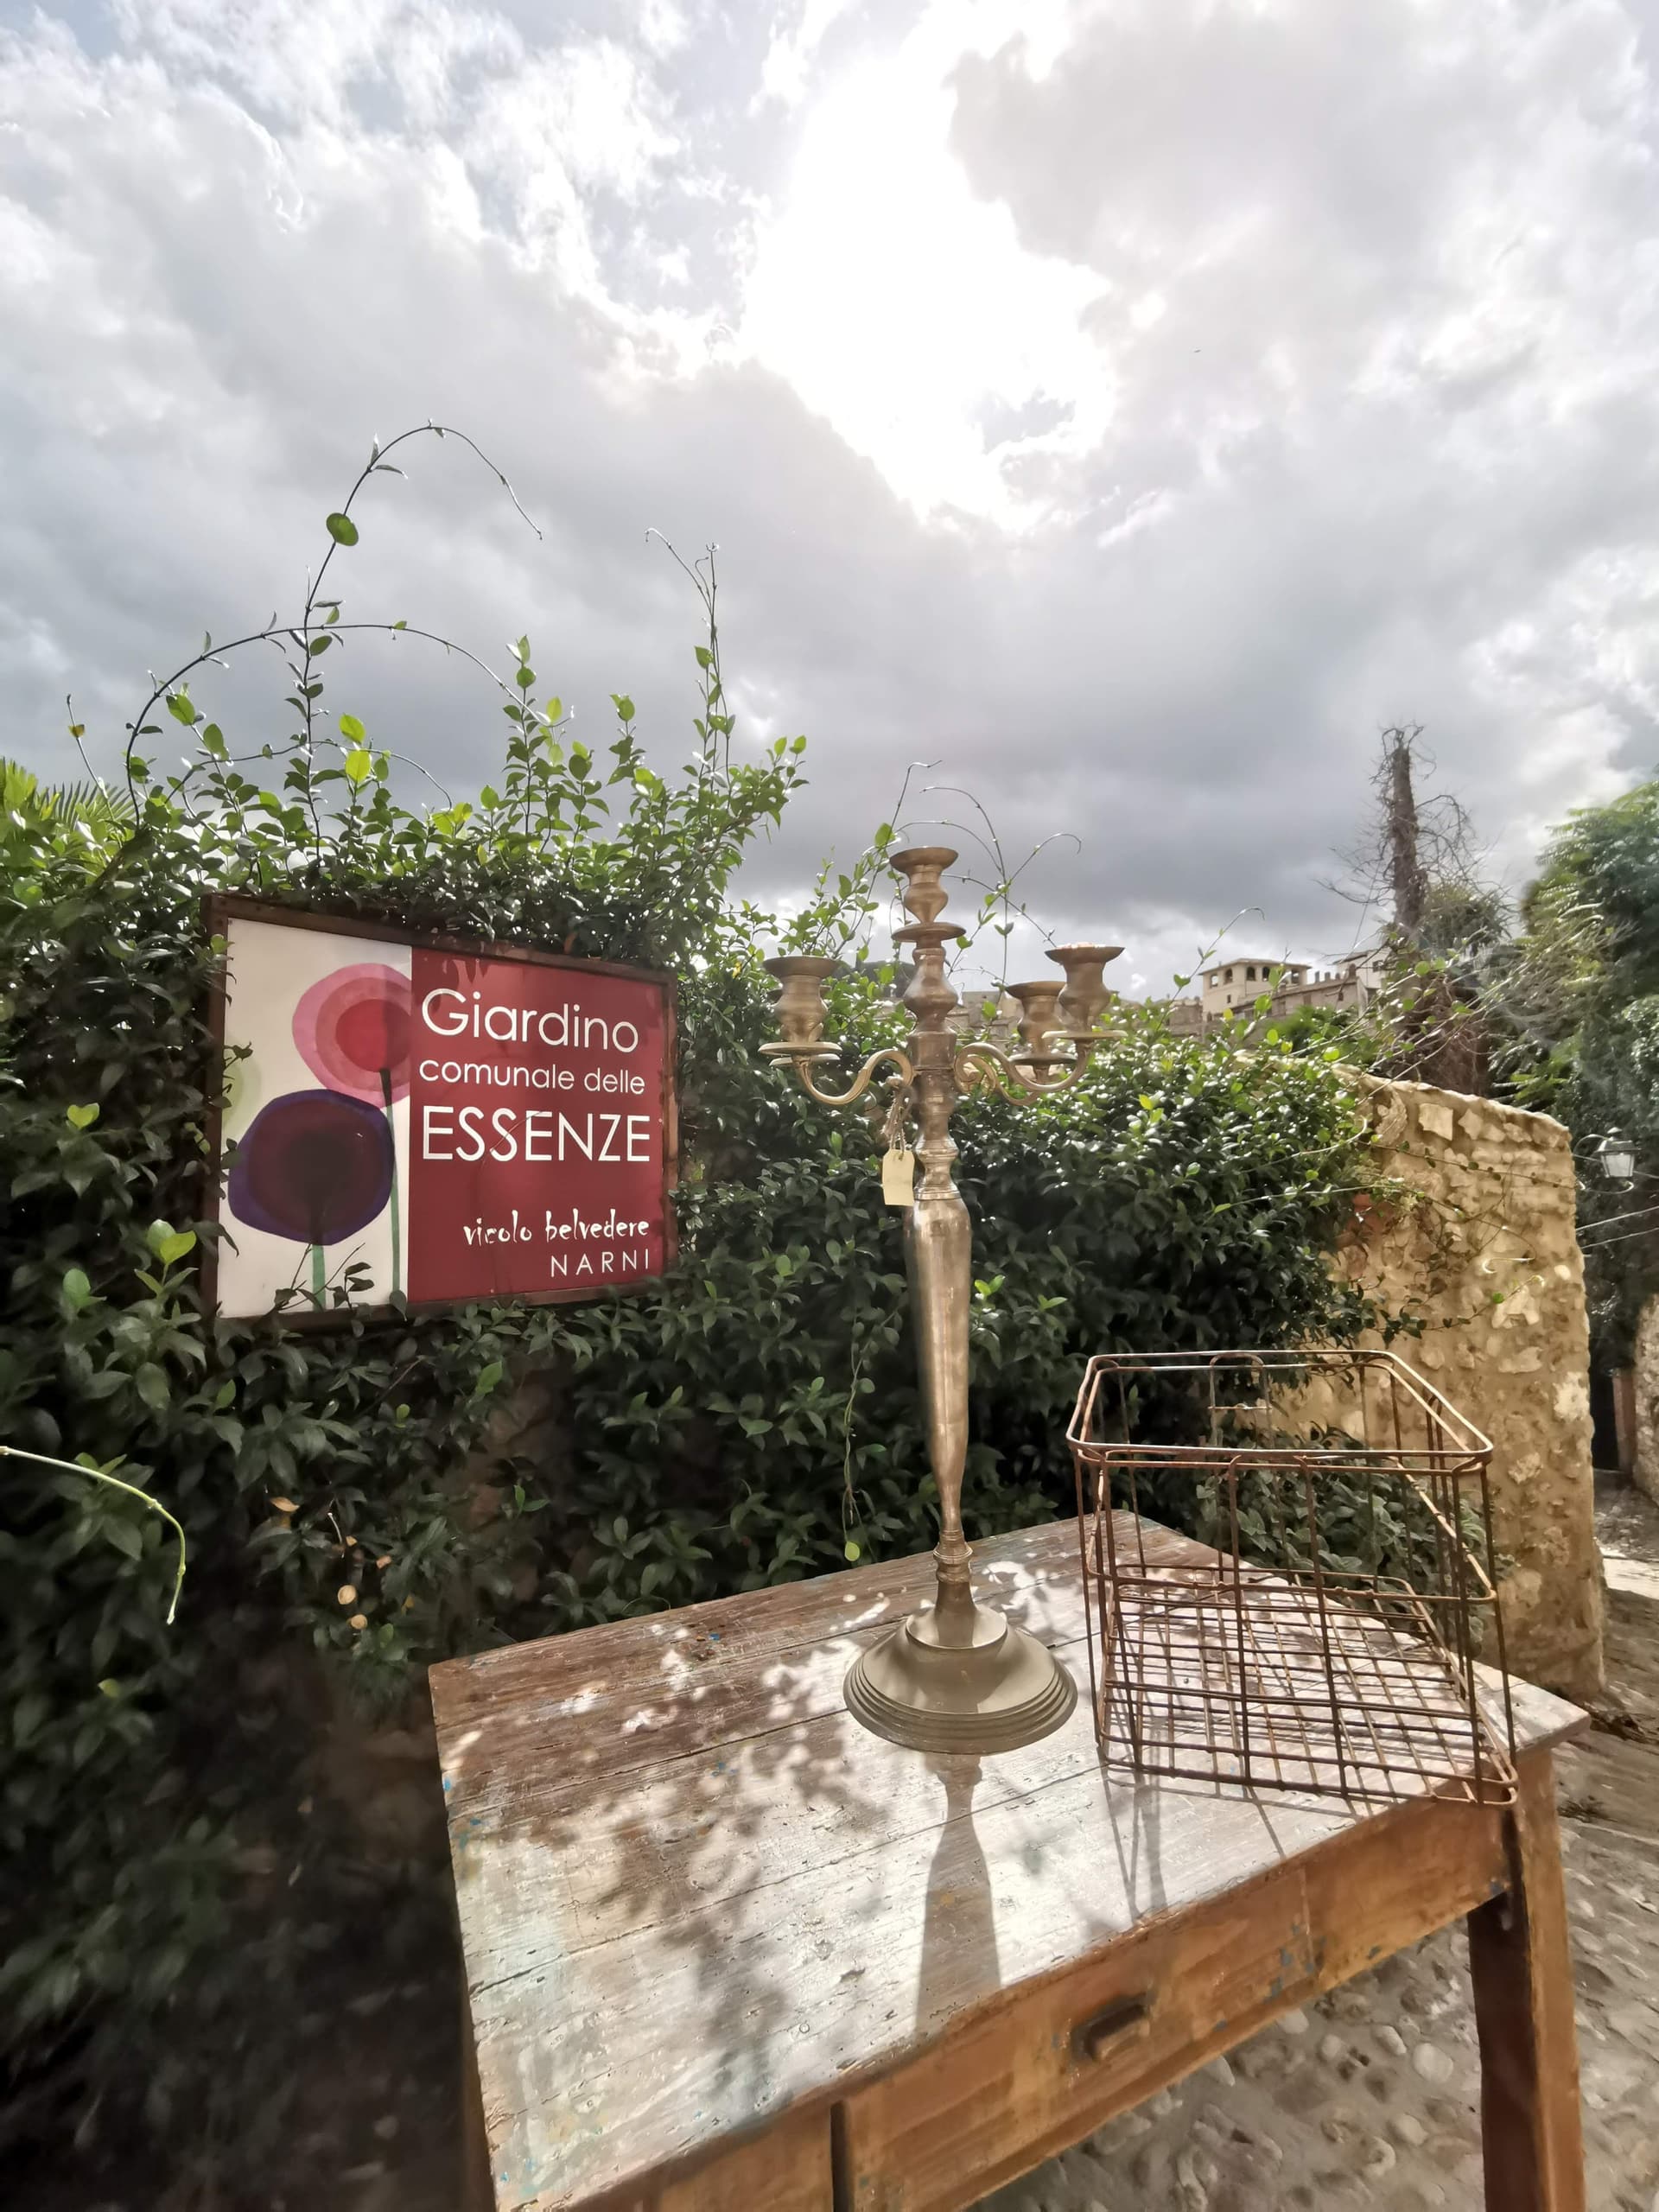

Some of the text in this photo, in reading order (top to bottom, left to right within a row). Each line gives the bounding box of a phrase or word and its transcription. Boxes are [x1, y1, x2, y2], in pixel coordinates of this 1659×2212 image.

[421, 988, 639, 1052] Giardino
[419, 1059, 645, 1095] comunale delle
[423, 1105, 650, 1162] ESSENZE
[463, 1208, 650, 1245] vicolo belvedere
[550, 1249, 649, 1277] NARNI
